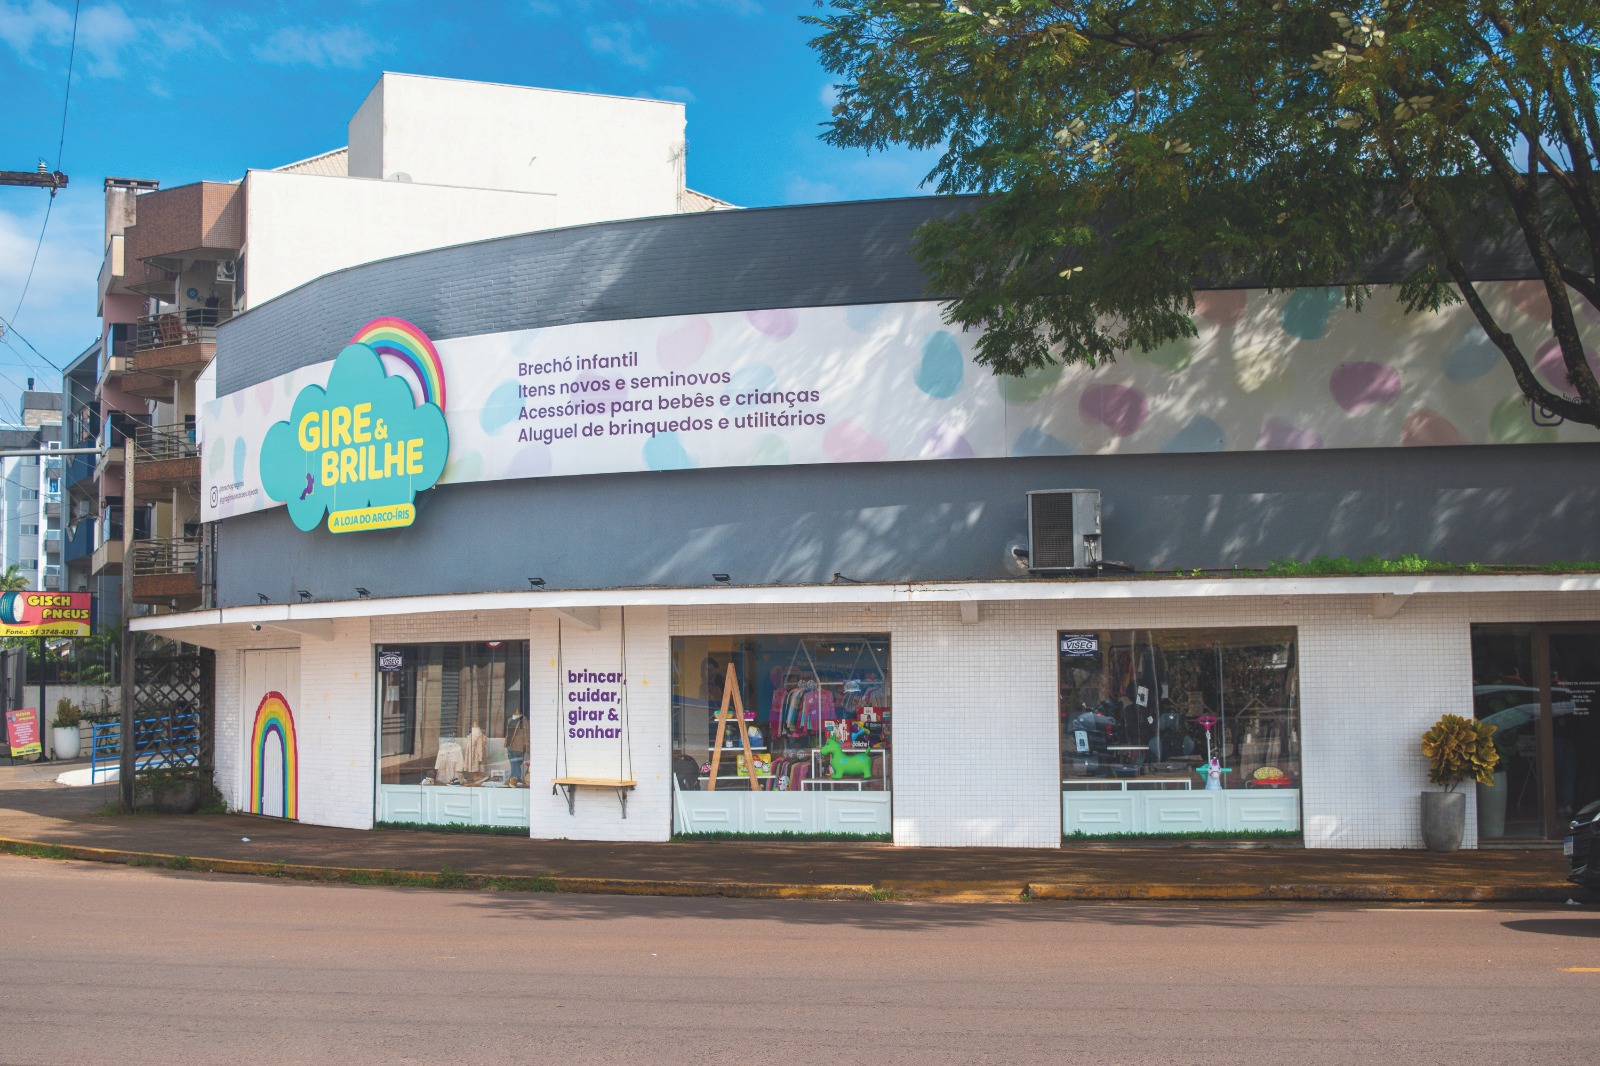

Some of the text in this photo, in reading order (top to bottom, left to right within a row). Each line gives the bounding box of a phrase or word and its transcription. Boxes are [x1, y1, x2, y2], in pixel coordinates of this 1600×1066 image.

[518, 351, 639, 377] Brechó infantil
[518, 369, 731, 399] Itens novos e seminovos
[518, 388, 820, 421] Acessórios para bebês e crianças
[298, 402, 388, 452] GIRE &
[518, 409, 826, 445] Aluguel de brinquedos e utilitários
[321, 437, 424, 487] BRILHE
[333, 509, 410, 527] A LOJA DO ARCO-ÍRIS
[27, 595, 71, 606] GISCH
[42, 608, 90, 619] PNEUS
[1066, 641, 1093, 649] VISEG
[568, 669, 627, 686] brincar,
[568, 688, 621, 705] cuidar,
[568, 707, 619, 725] girar &
[568, 725, 622, 739] sonhar
